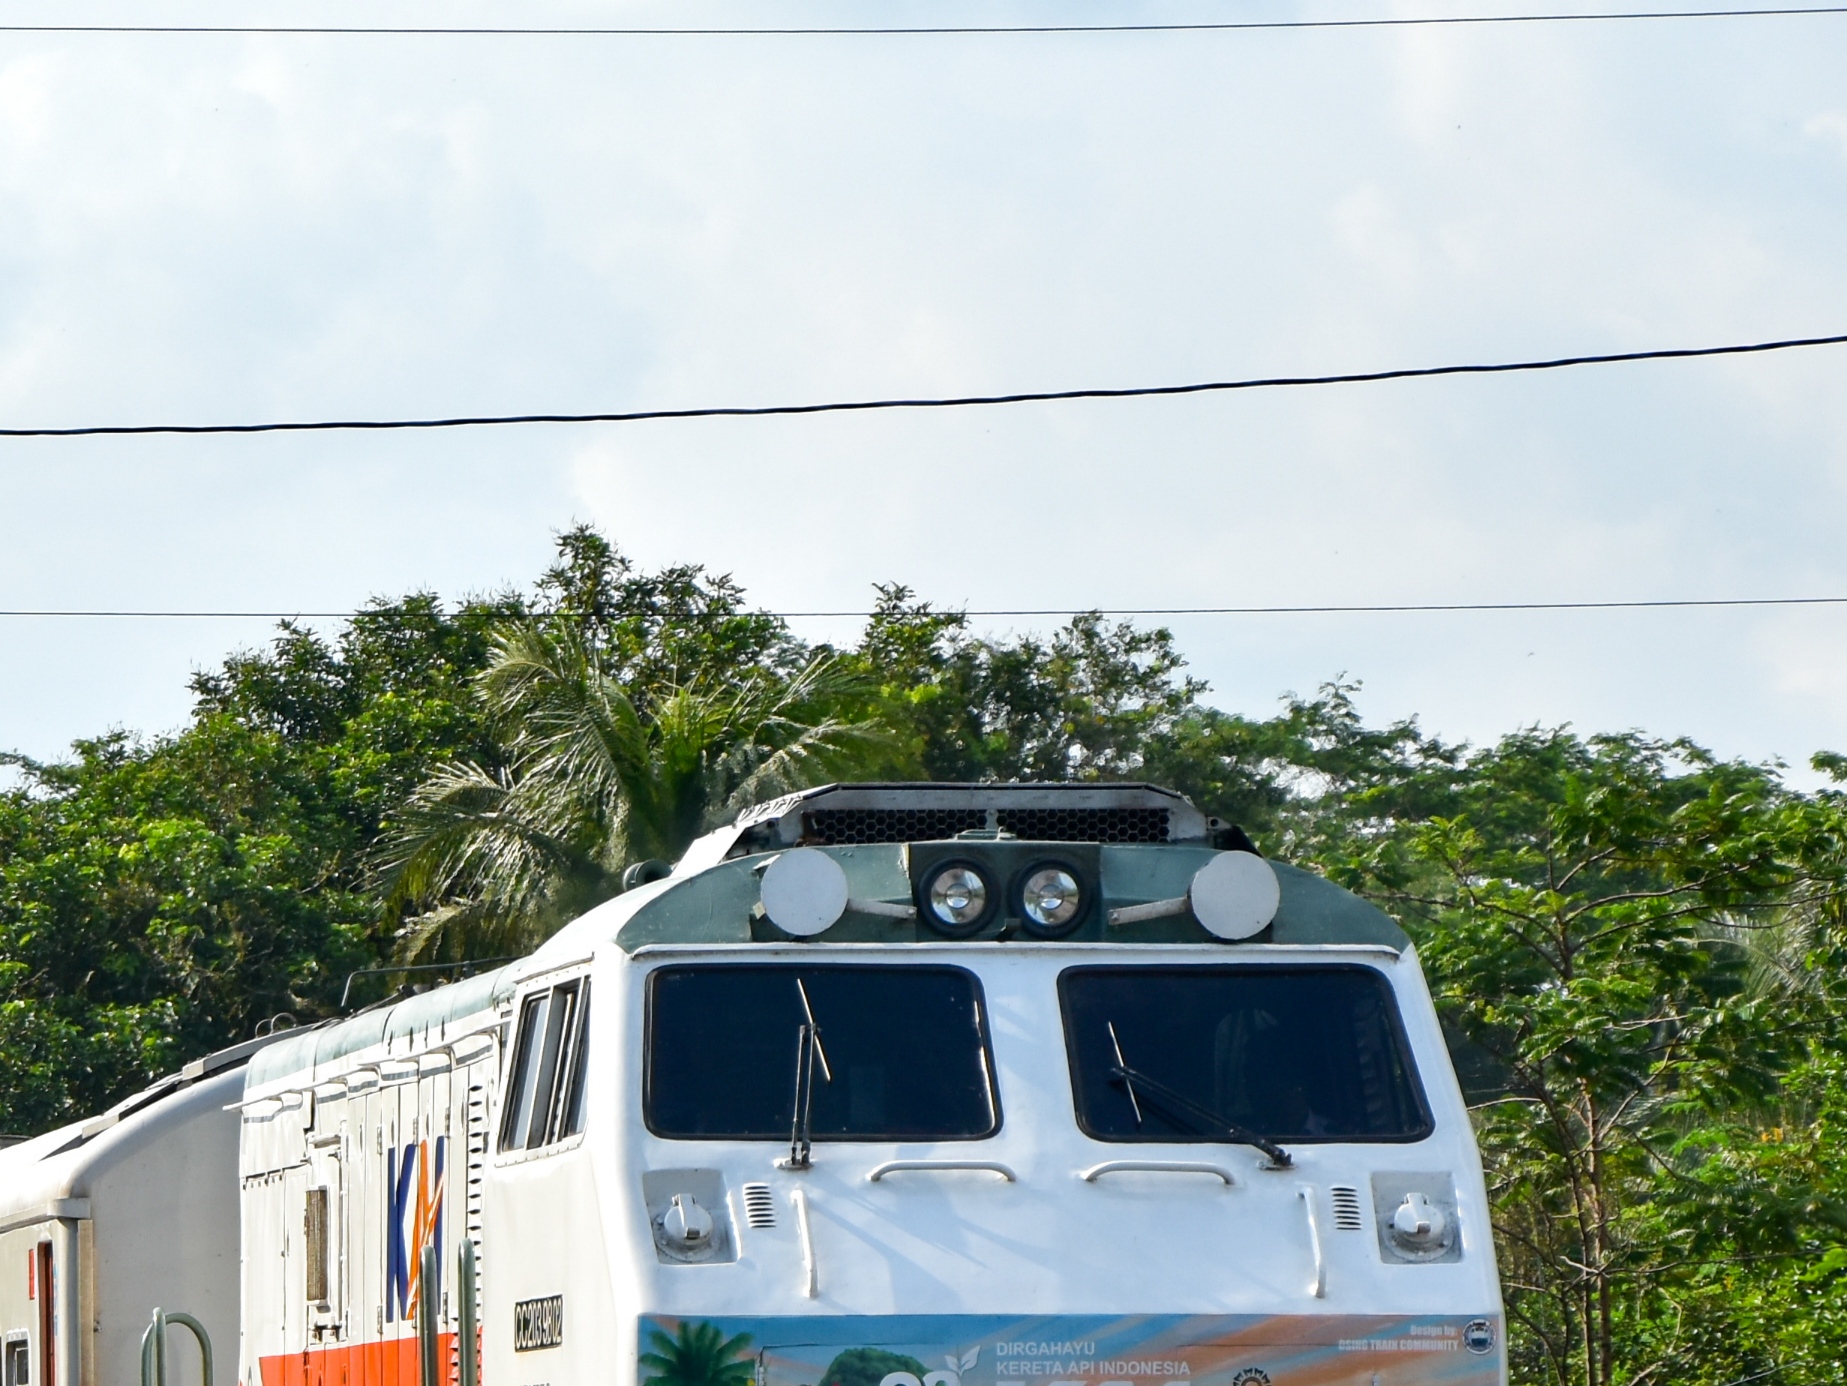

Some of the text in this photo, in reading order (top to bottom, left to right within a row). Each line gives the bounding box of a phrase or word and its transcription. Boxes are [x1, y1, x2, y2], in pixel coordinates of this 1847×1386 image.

[1410, 1325, 1443, 1337] Design
[997, 1342, 1095, 1356] DIRGAHAYU
[1370, 1339, 1398, 1351] TRAIN
[1399, 1339, 1459, 1351] COMMUNITY
[997, 1361, 1190, 1375] KERETA API INDONESIA
